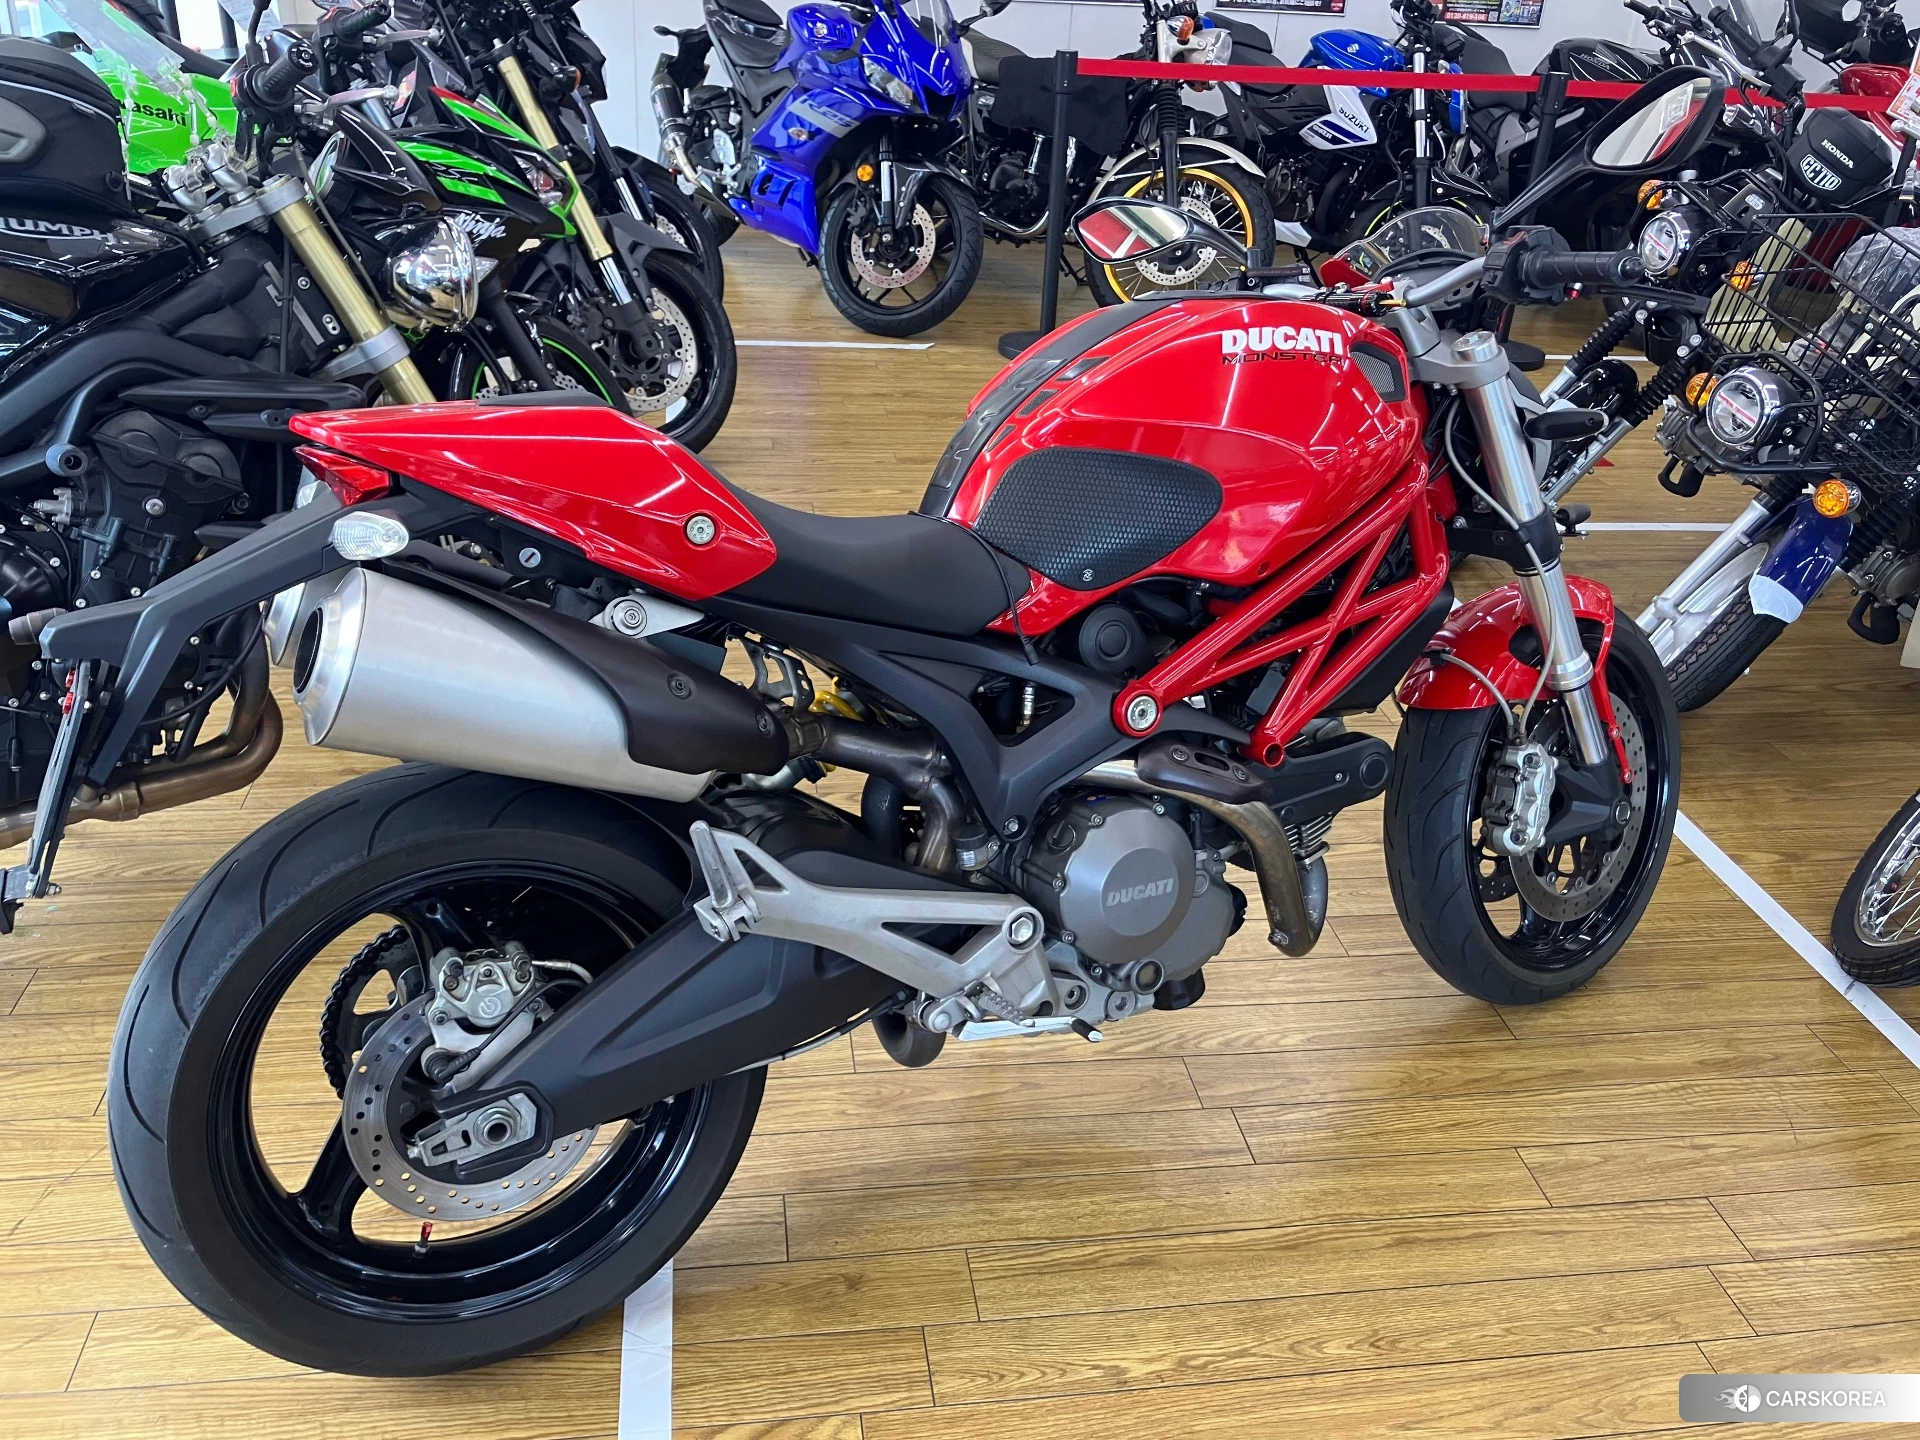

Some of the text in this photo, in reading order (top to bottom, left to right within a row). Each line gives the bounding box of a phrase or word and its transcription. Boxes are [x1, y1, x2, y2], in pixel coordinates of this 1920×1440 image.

[1579, 53, 1610, 70] HONDA
[1338, 105, 1370, 134] SUZUKI
[1820, 138, 1855, 169] HONDA
[1801, 156, 1840, 189] CC110
[1221, 326, 1344, 355] DUCATI
[1222, 351, 1344, 365] MONSTER
[1106, 878, 1174, 907] DUCATI
